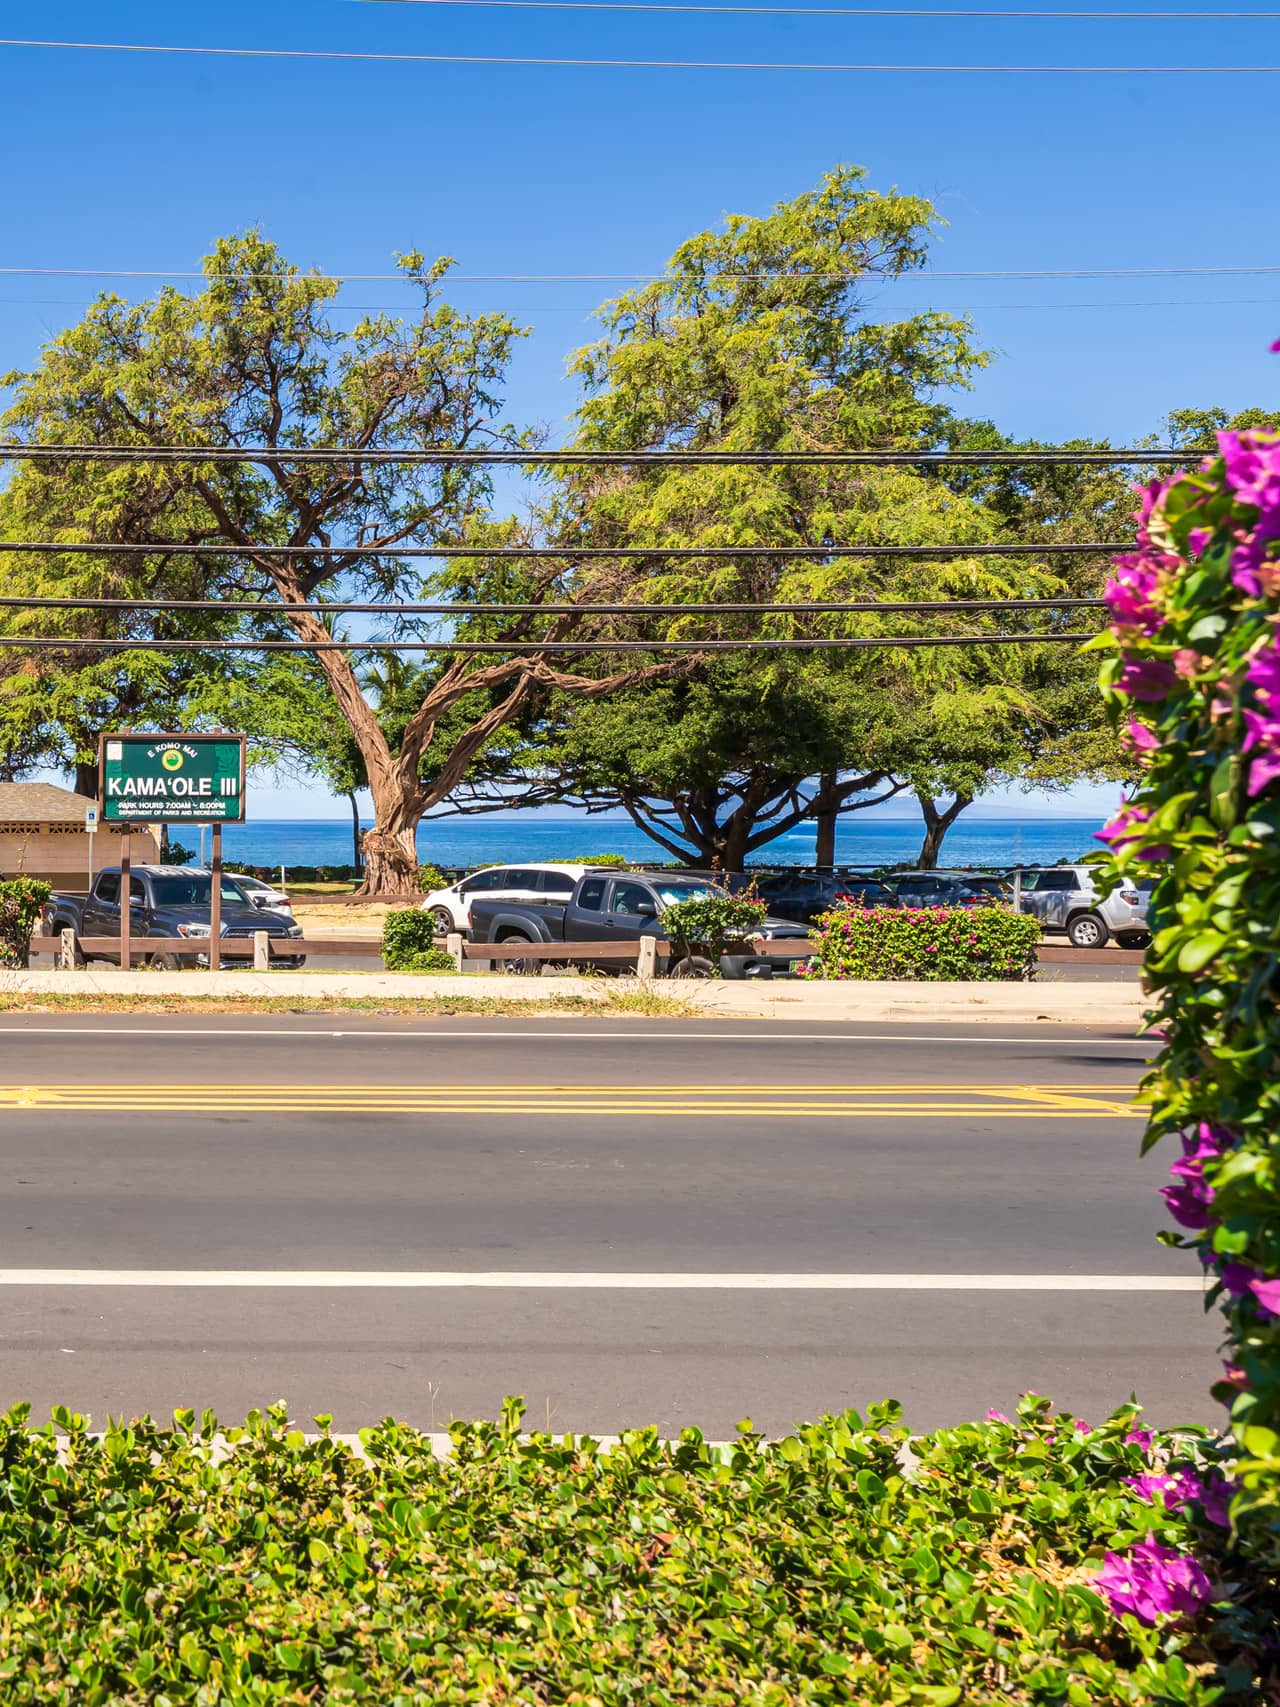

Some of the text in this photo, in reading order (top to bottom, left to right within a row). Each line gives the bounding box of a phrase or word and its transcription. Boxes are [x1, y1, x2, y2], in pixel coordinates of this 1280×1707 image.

[147, 742, 198, 758] E KOMO MAI
[220, 778, 237, 796] III
[118, 801, 137, 809] PARK
[139, 801, 164, 809] HOURS
